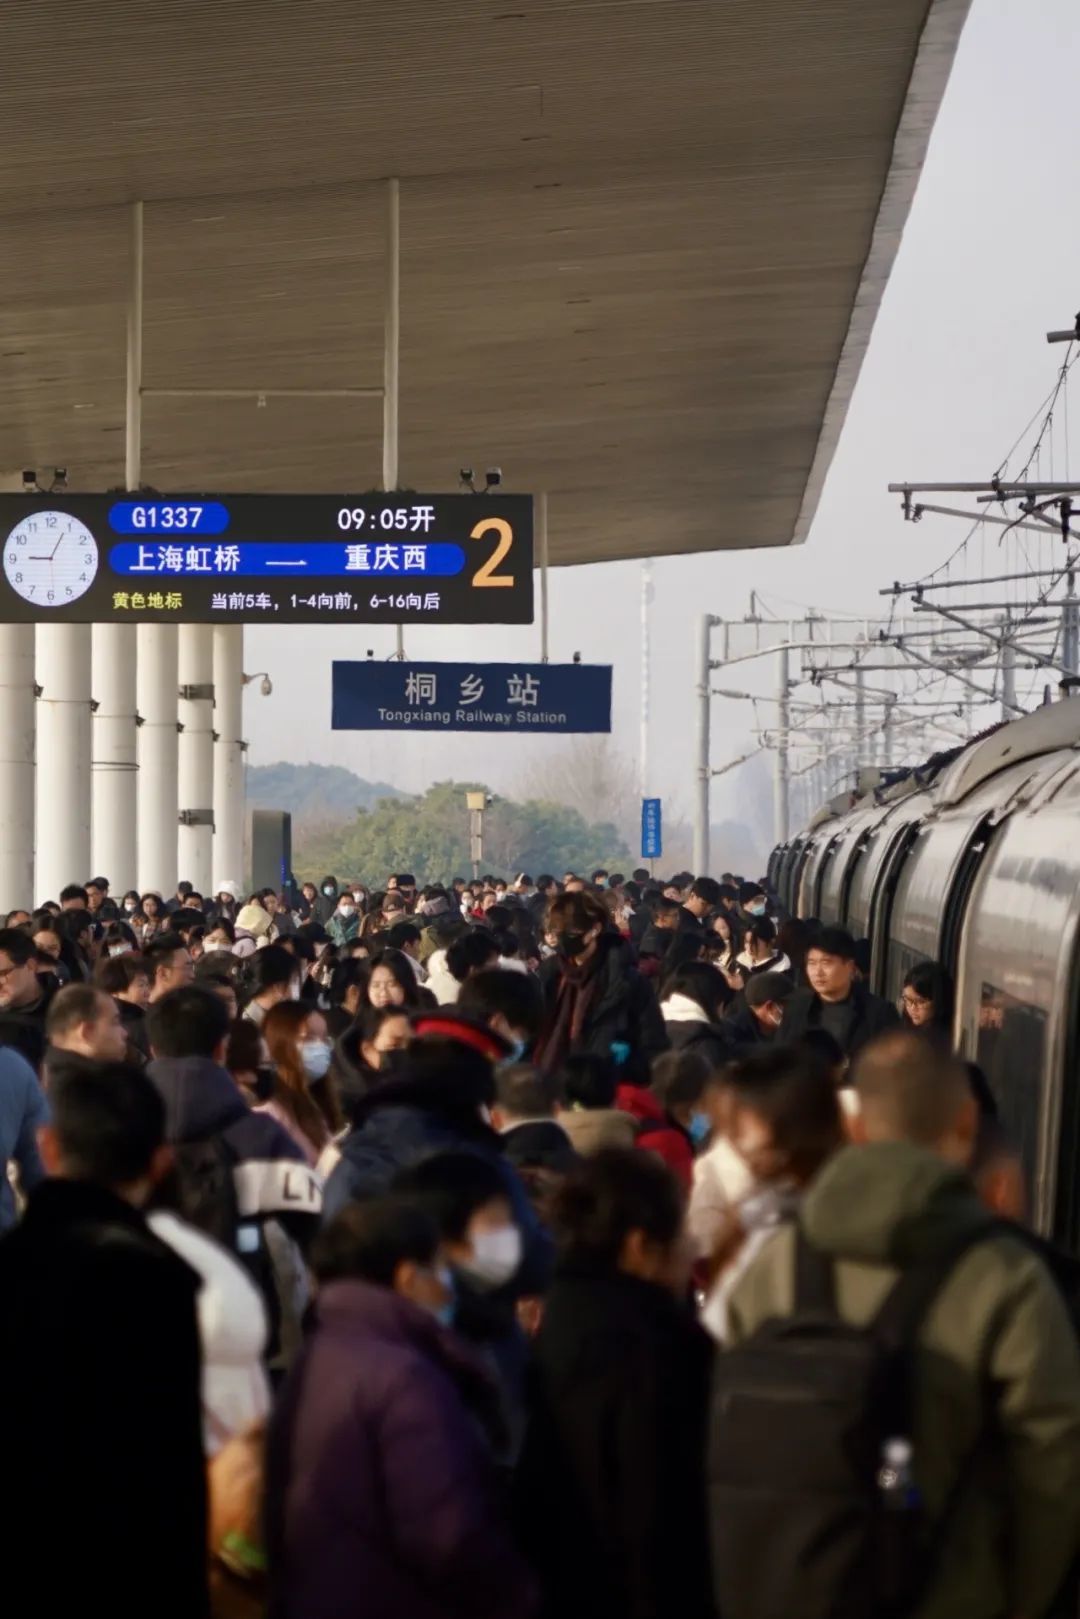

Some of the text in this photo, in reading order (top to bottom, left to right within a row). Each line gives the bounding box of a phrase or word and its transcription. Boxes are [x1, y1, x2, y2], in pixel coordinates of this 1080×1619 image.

[45, 517, 57, 528] 12
[132, 507, 203, 528] G1337
[338, 505, 435, 532] 09:05开
[28, 523, 37, 532] 11
[16, 534, 27, 545] 10
[79, 535, 88, 545] 2
[470, 517, 514, 587] 2
[9, 553, 17, 564] 9
[84, 554, 92, 565] 3
[129, 544, 427, 572] 上海虹桥 重庆西
[15, 572, 23, 583] 8
[80, 572, 87, 582] 4
[29, 585, 36, 595] 7
[47, 590, 55, 601] 6
[65, 586, 73, 595] 5
[112, 592, 183, 610] 黄色地标
[378, 708, 567, 725] Tongxiang Railway Station
